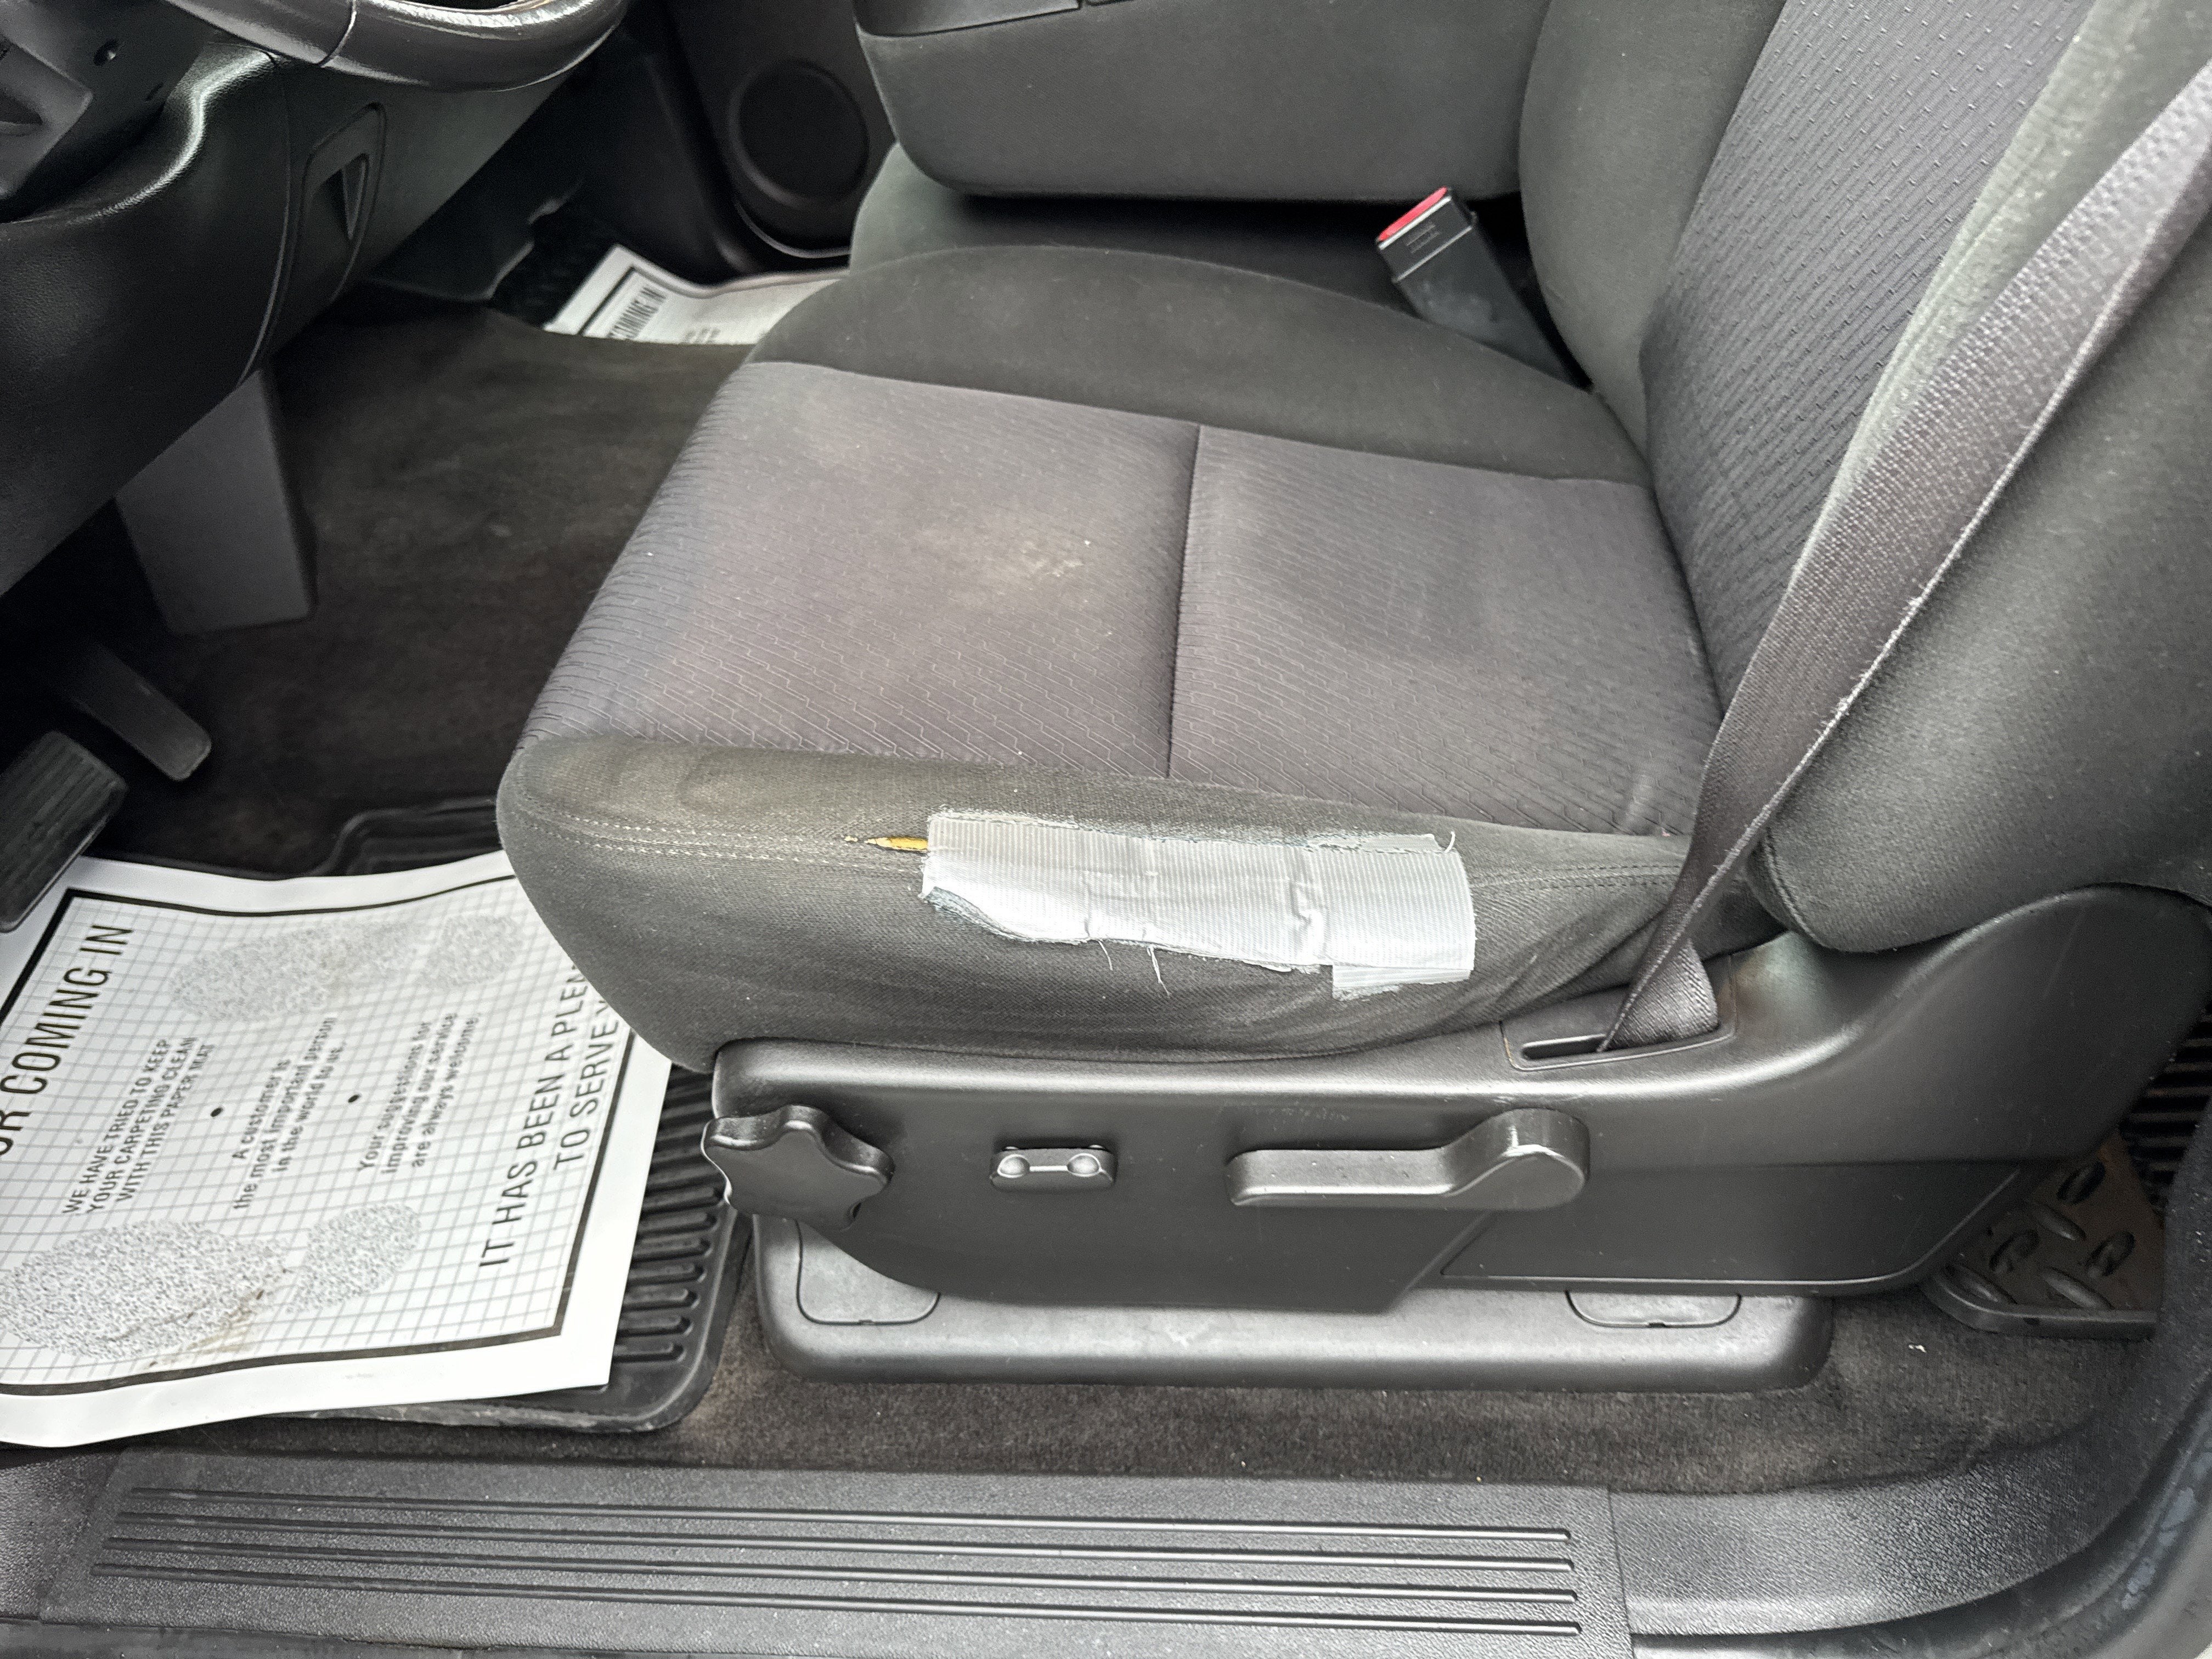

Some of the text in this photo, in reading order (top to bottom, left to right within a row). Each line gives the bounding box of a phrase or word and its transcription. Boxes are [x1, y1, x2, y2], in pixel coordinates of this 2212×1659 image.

[0, 968, 112, 1094] COMING
[80, 925, 133, 955] IN
[314, 1065, 334, 1080] to
[544, 1044, 574, 1062] A
[62, 1039, 171, 1214] WE HAVE TRIED TO KEEP
[86, 1037, 198, 1214] YOUR CARPETING CLEAN
[116, 1043, 215, 1201] WITH THIS PAPER MAT
[232, 1059, 291, 1159] A customer is
[233, 1017, 336, 1209] the most important person
[295, 1082, 325, 1122] world
[357, 1022, 432, 1172] Your suggestions for
[381, 1013, 458, 1173] improving our service
[420, 1085, 454, 1136] always
[516, 1073, 565, 1150] BEEN
[553, 1020, 619, 1171] TO SERVE
[272, 1156, 292, 1172] in
[281, 1126, 303, 1152] the
[411, 1141, 431, 1167] are
[492, 1159, 538, 1224] HAS
[479, 1238, 515, 1267] IT
